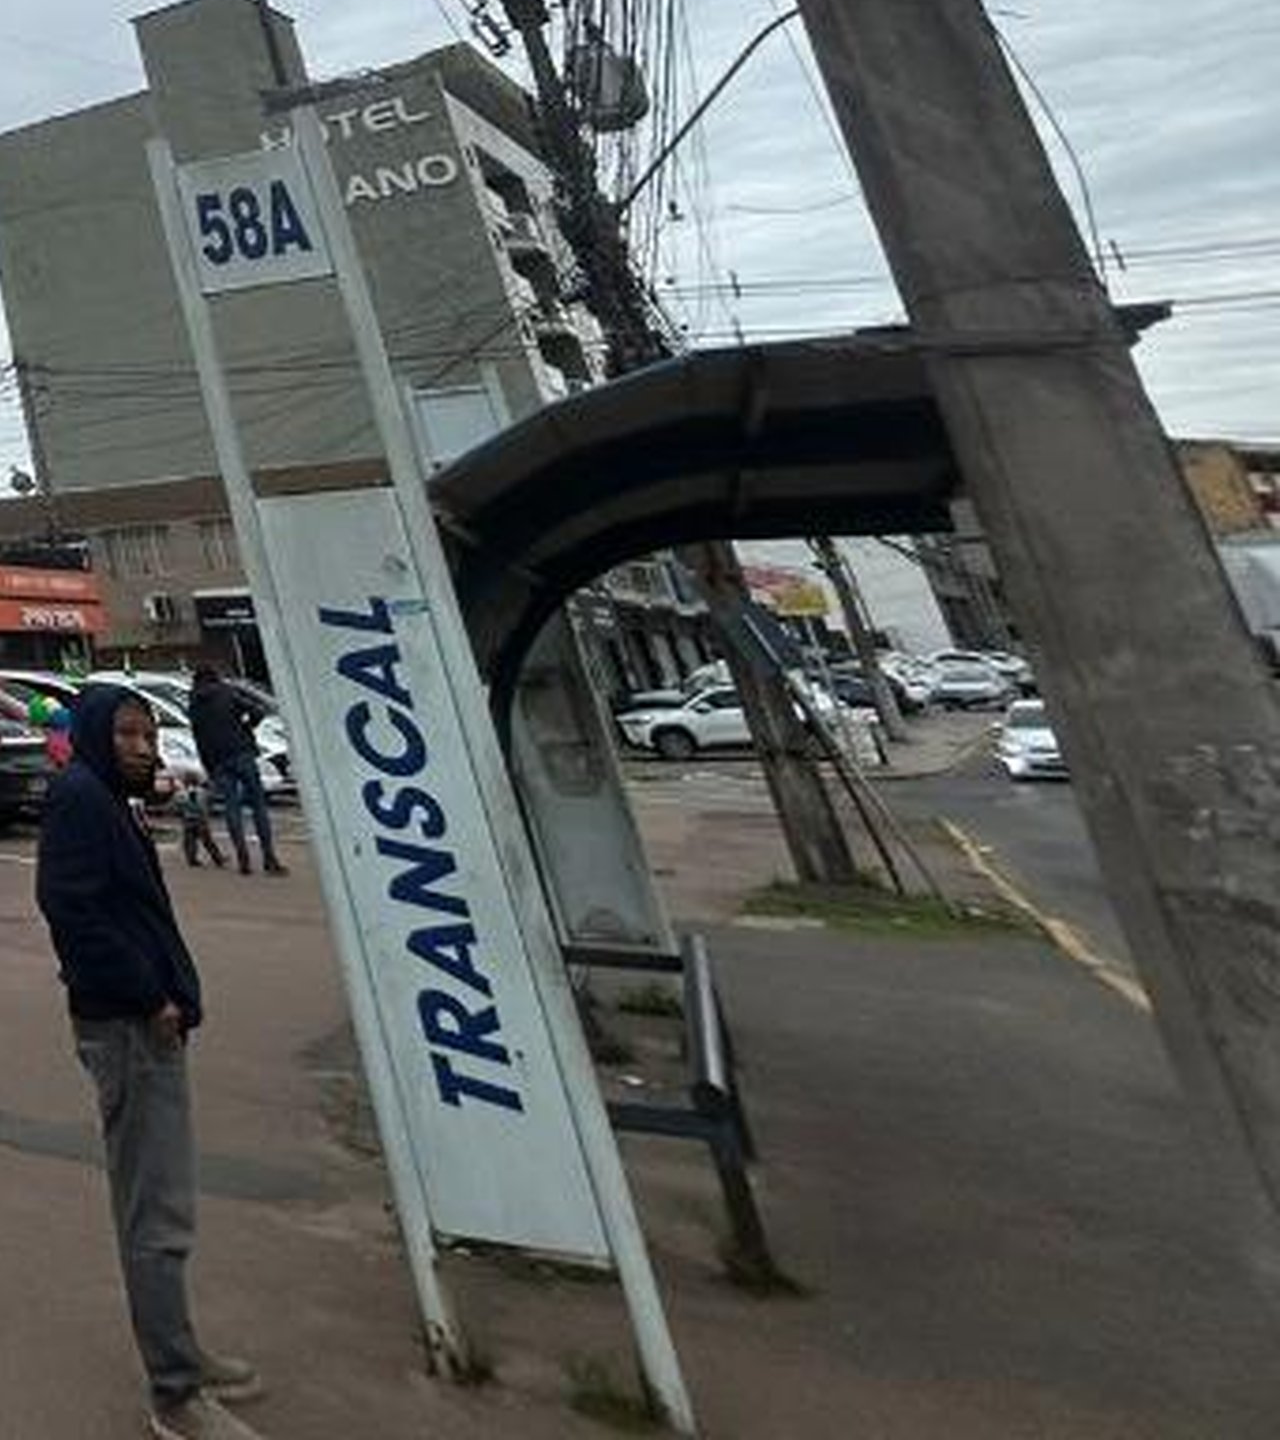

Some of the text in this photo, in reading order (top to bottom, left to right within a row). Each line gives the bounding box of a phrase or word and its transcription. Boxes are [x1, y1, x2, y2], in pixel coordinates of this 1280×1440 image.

[259, 97, 431, 151] HTEL
[196, 178, 314, 266] 58A
[317, 594, 526, 1115] TRANSCAL
